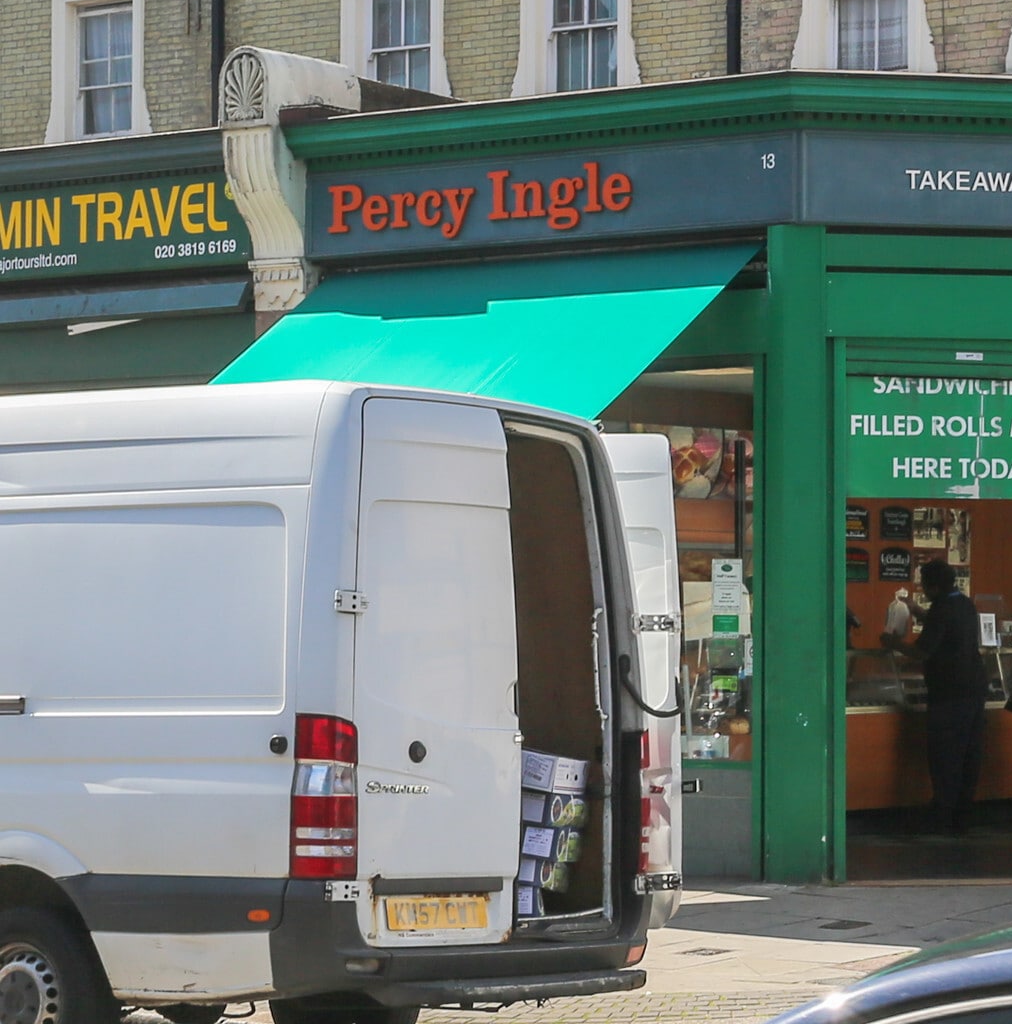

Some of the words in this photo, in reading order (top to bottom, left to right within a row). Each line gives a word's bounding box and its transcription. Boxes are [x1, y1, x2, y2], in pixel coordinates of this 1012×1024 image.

[761, 153, 775, 169] 13
[327, 184, 476, 239] Percy
[486, 162, 633, 230] Ingle
[72, 182, 228, 244] TRAVEL
[154, 244, 175, 259] 020
[178, 241, 205, 257] 3819
[208, 239, 236, 254] 6169
[850, 414, 924, 436] FILLED
[931, 416, 1003, 437] ROLLS
[893, 457, 952, 478] HERE
